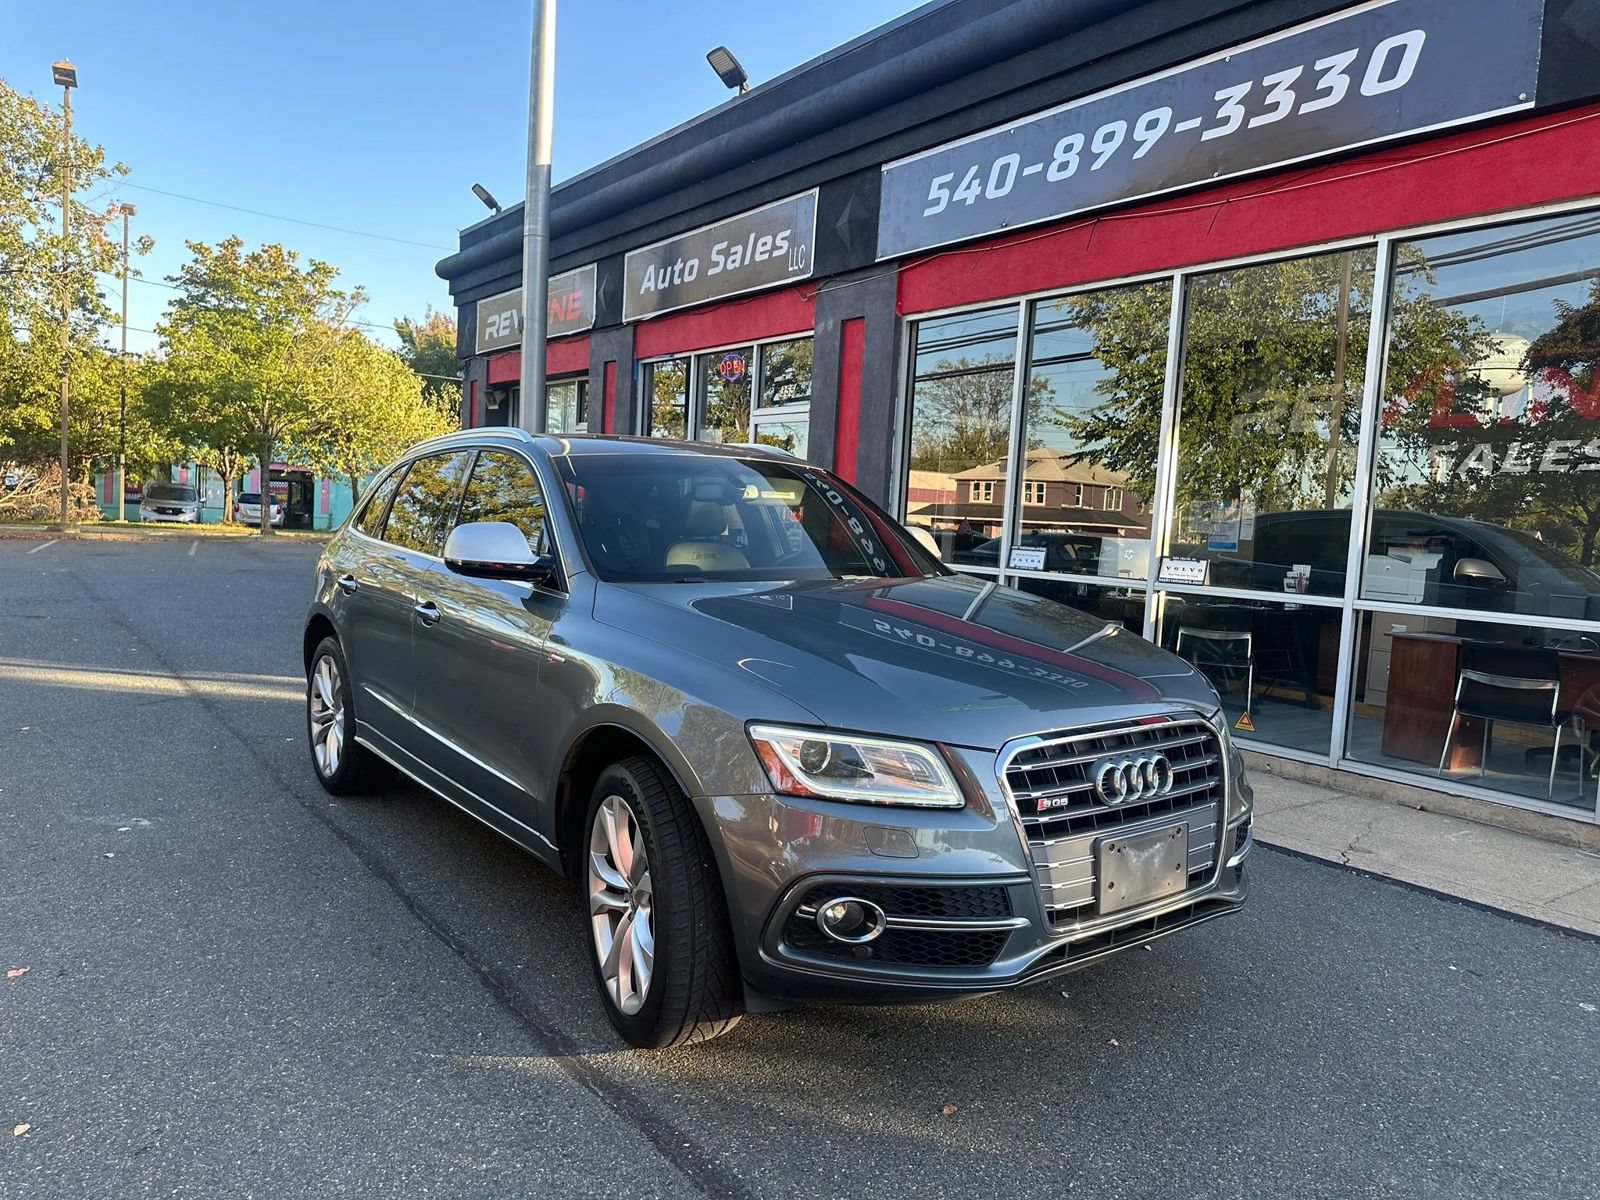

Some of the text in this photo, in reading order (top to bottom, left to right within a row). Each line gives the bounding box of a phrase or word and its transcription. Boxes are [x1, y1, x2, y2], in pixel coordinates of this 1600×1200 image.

[922, 29, 1427, 219] 540-899-3330
[639, 228, 792, 295] Auto Sales
[788, 244, 806, 271] LLC
[720, 360, 745, 375] OPEN
[1166, 565, 1203, 573] VOLVO
[1043, 797, 1068, 808] SQ5
